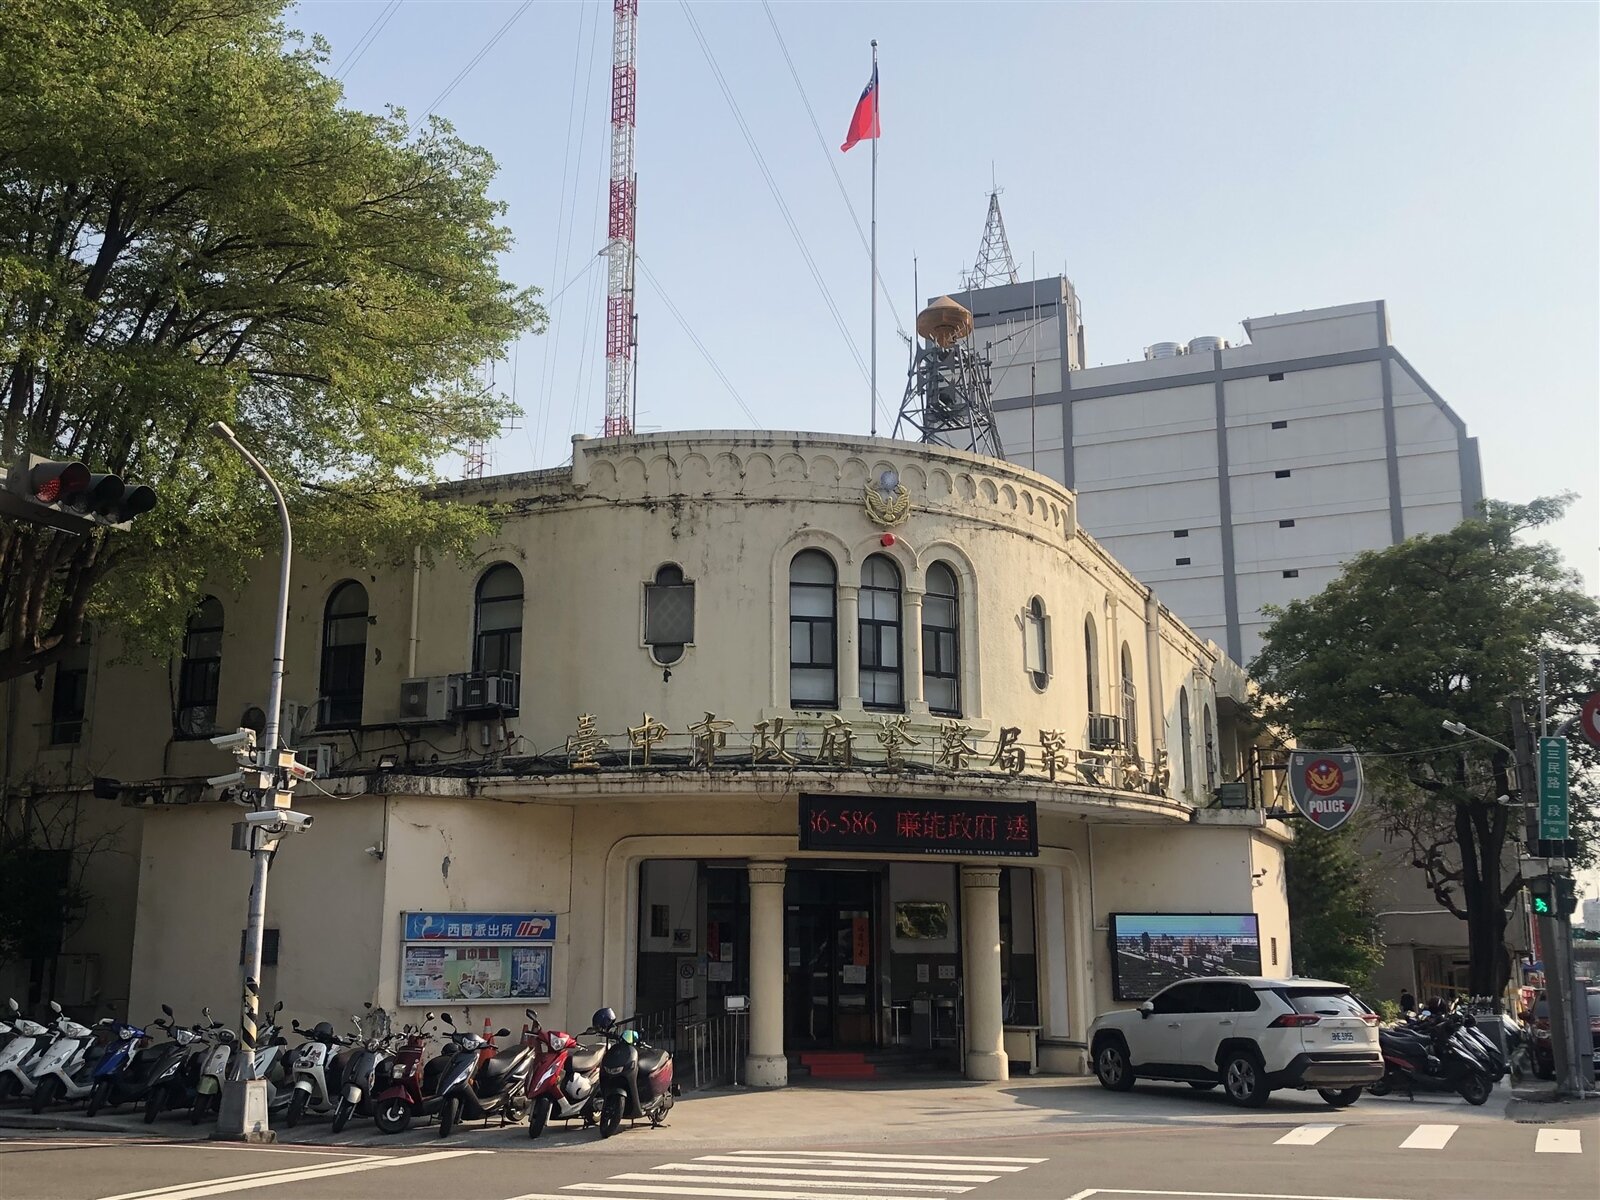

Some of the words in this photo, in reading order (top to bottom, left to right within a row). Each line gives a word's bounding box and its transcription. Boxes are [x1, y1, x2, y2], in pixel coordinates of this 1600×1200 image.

[1546, 749, 1561, 817] 三民路一段
[1309, 800, 1346, 813] POLICE
[895, 811, 998, 841] 廉能政府
[1005, 813, 1030, 841] 透
[447, 923, 513, 937] 西區派出所
